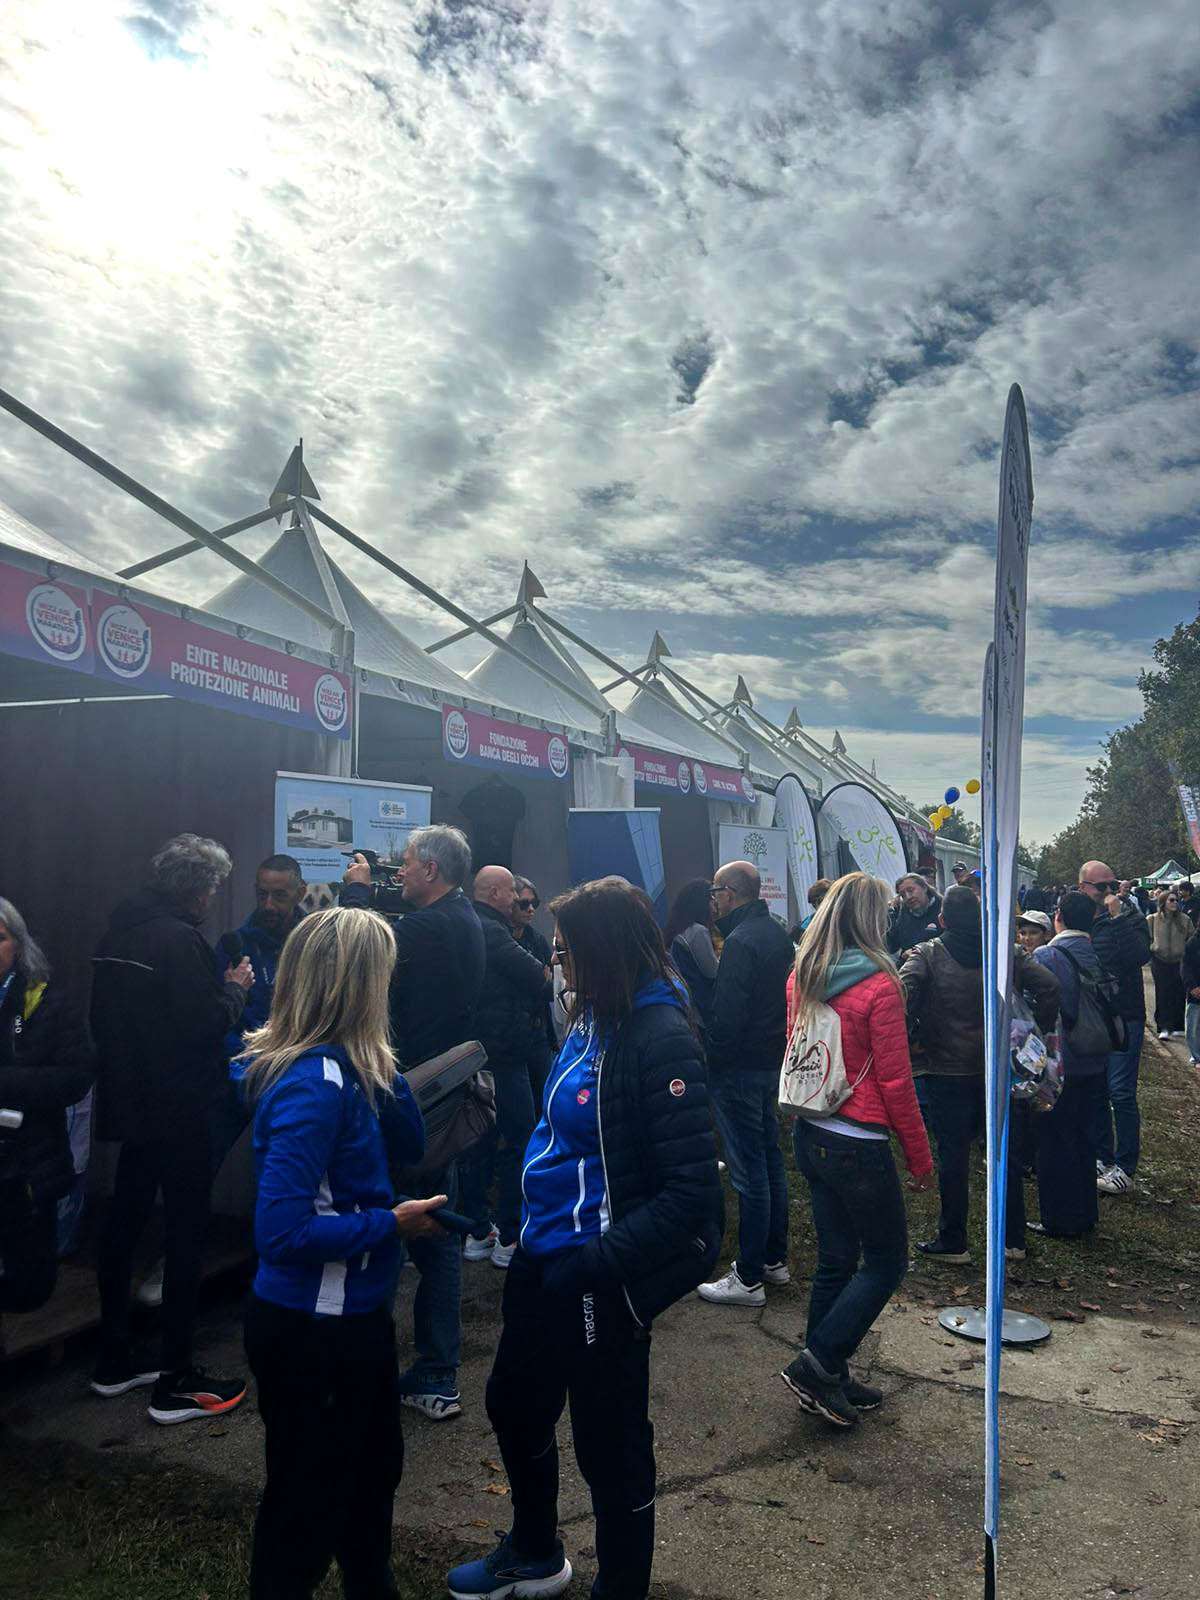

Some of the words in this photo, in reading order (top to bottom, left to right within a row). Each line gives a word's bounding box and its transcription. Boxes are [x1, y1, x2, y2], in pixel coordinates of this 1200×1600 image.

[36, 608, 74, 627] VENICE
[107, 627, 143, 646] VENICE
[186, 643, 220, 670] ENTE
[223, 655, 288, 691] NAZIONALE
[170, 661, 249, 700] PROTEZIONE
[252, 685, 300, 713] ANIMALI
[489, 731, 528, 752] FONDAZIONE
[479, 743, 502, 761] BANCA
[502, 749, 520, 765] DEGLI
[520, 752, 540, 768] OCCHI
[585, 1292, 595, 1346] macron
